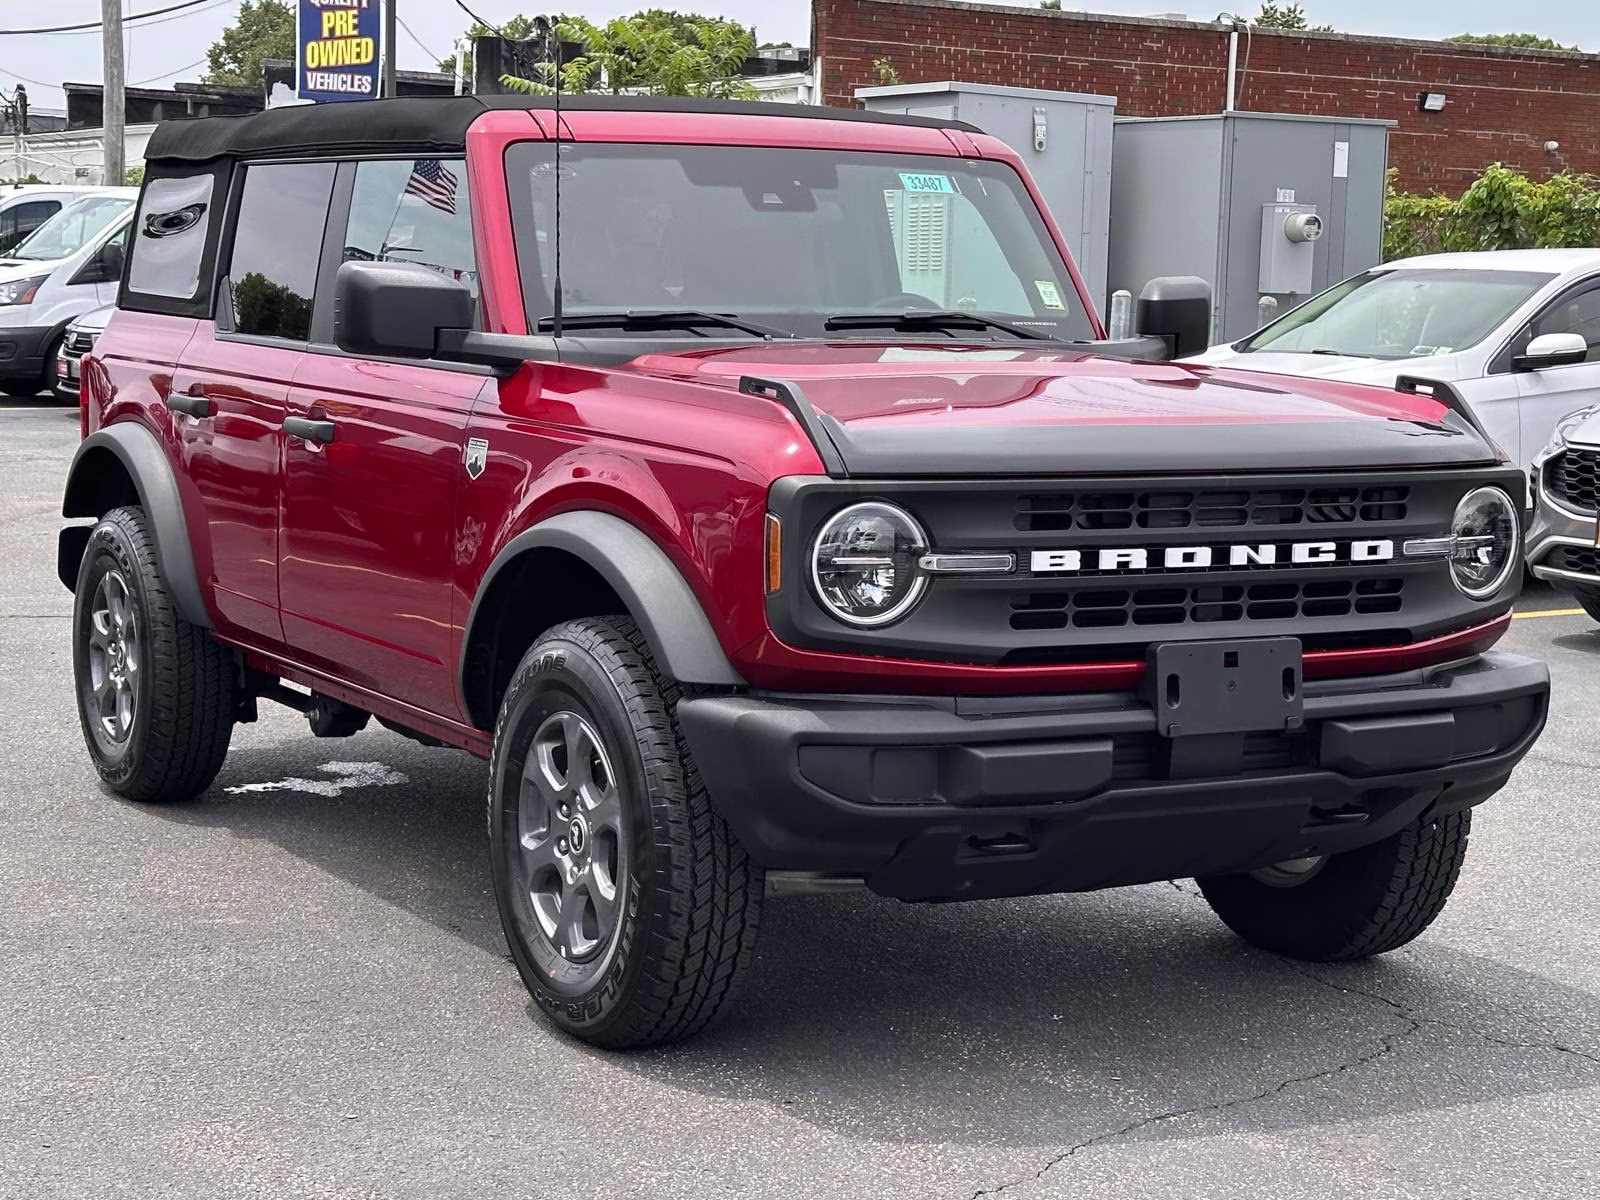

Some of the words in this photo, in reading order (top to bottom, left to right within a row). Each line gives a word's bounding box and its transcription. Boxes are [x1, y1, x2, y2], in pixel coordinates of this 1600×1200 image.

[322, 10, 359, 38] PRE
[306, 37, 373, 68] OWNED
[306, 71, 372, 93] VEHICLES
[907, 175, 943, 191] 33487
[1030, 540, 1394, 572] BRONCO
